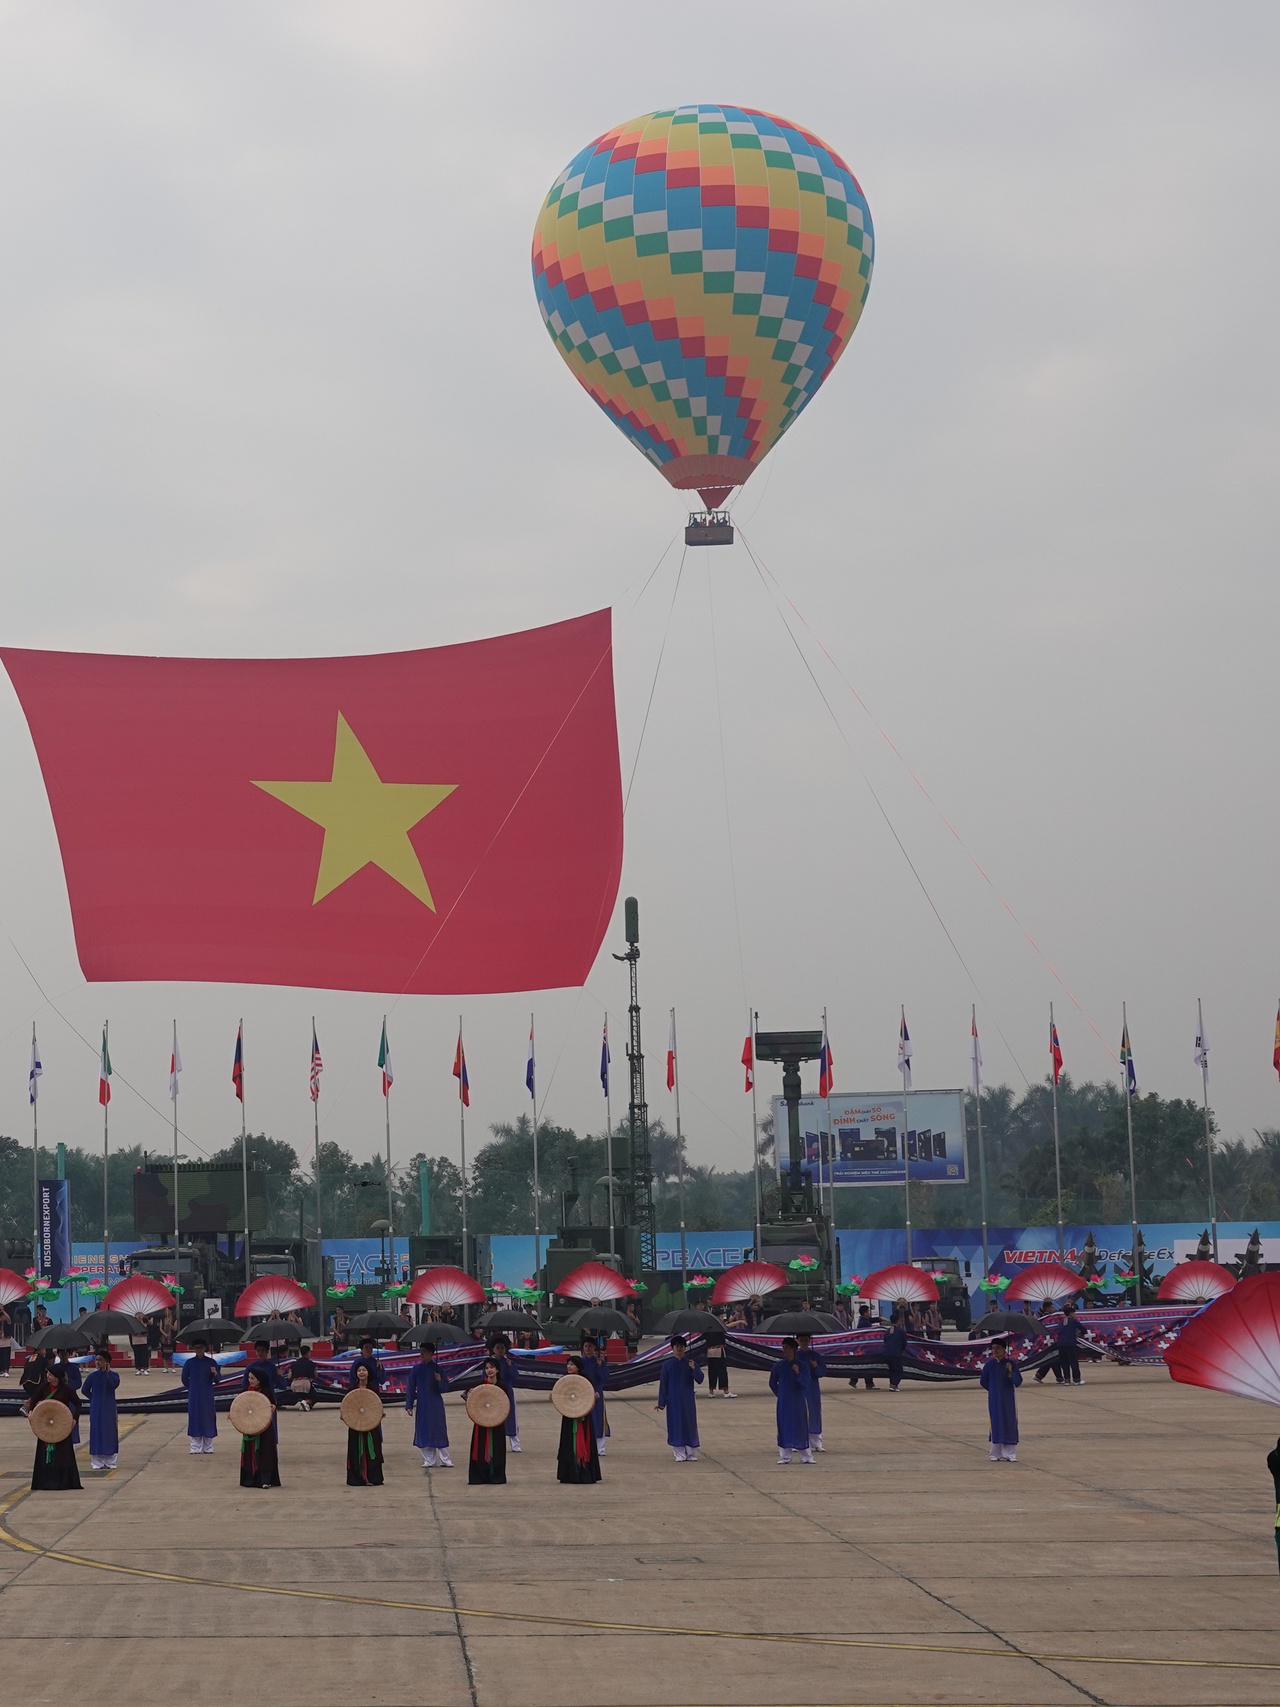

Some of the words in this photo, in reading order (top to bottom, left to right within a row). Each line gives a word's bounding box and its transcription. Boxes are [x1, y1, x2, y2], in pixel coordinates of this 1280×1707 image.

[42, 1186, 51, 1268] ROSOBORNEXPORT
[330, 1253, 399, 1275] EACE
[656, 1247, 741, 1269] PEACE
[1004, 1248, 1085, 1265] VIETNA
